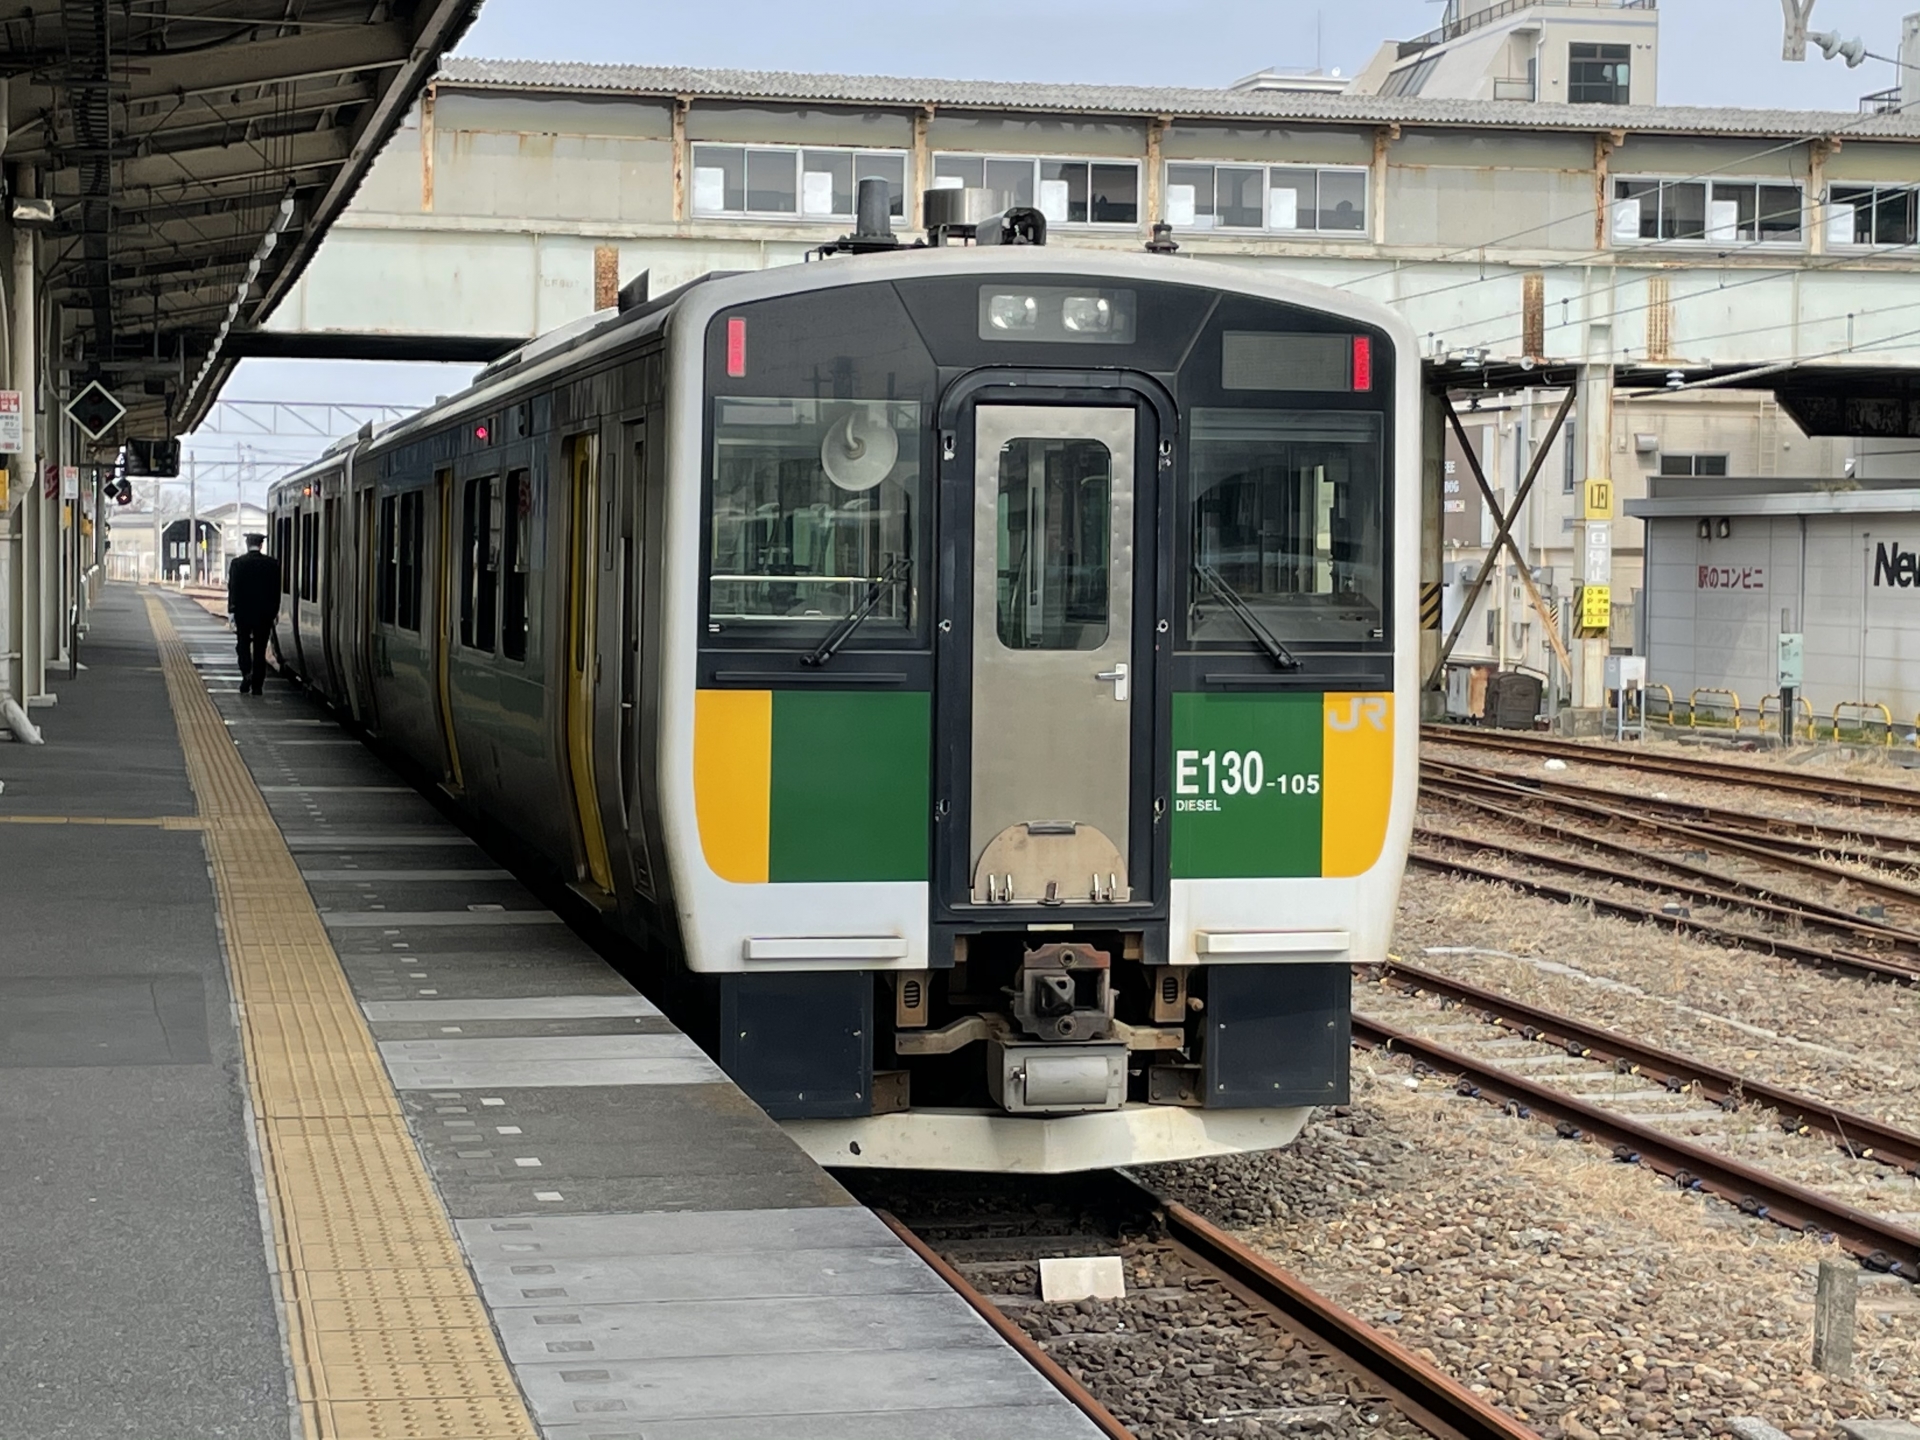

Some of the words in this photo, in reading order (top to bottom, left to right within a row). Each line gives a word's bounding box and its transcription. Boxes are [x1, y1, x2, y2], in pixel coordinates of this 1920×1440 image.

[1698, 565, 1764, 589] 駅のコンビニ
[1328, 697, 1387, 732] JR
[1175, 799, 1222, 812] DIESEL
